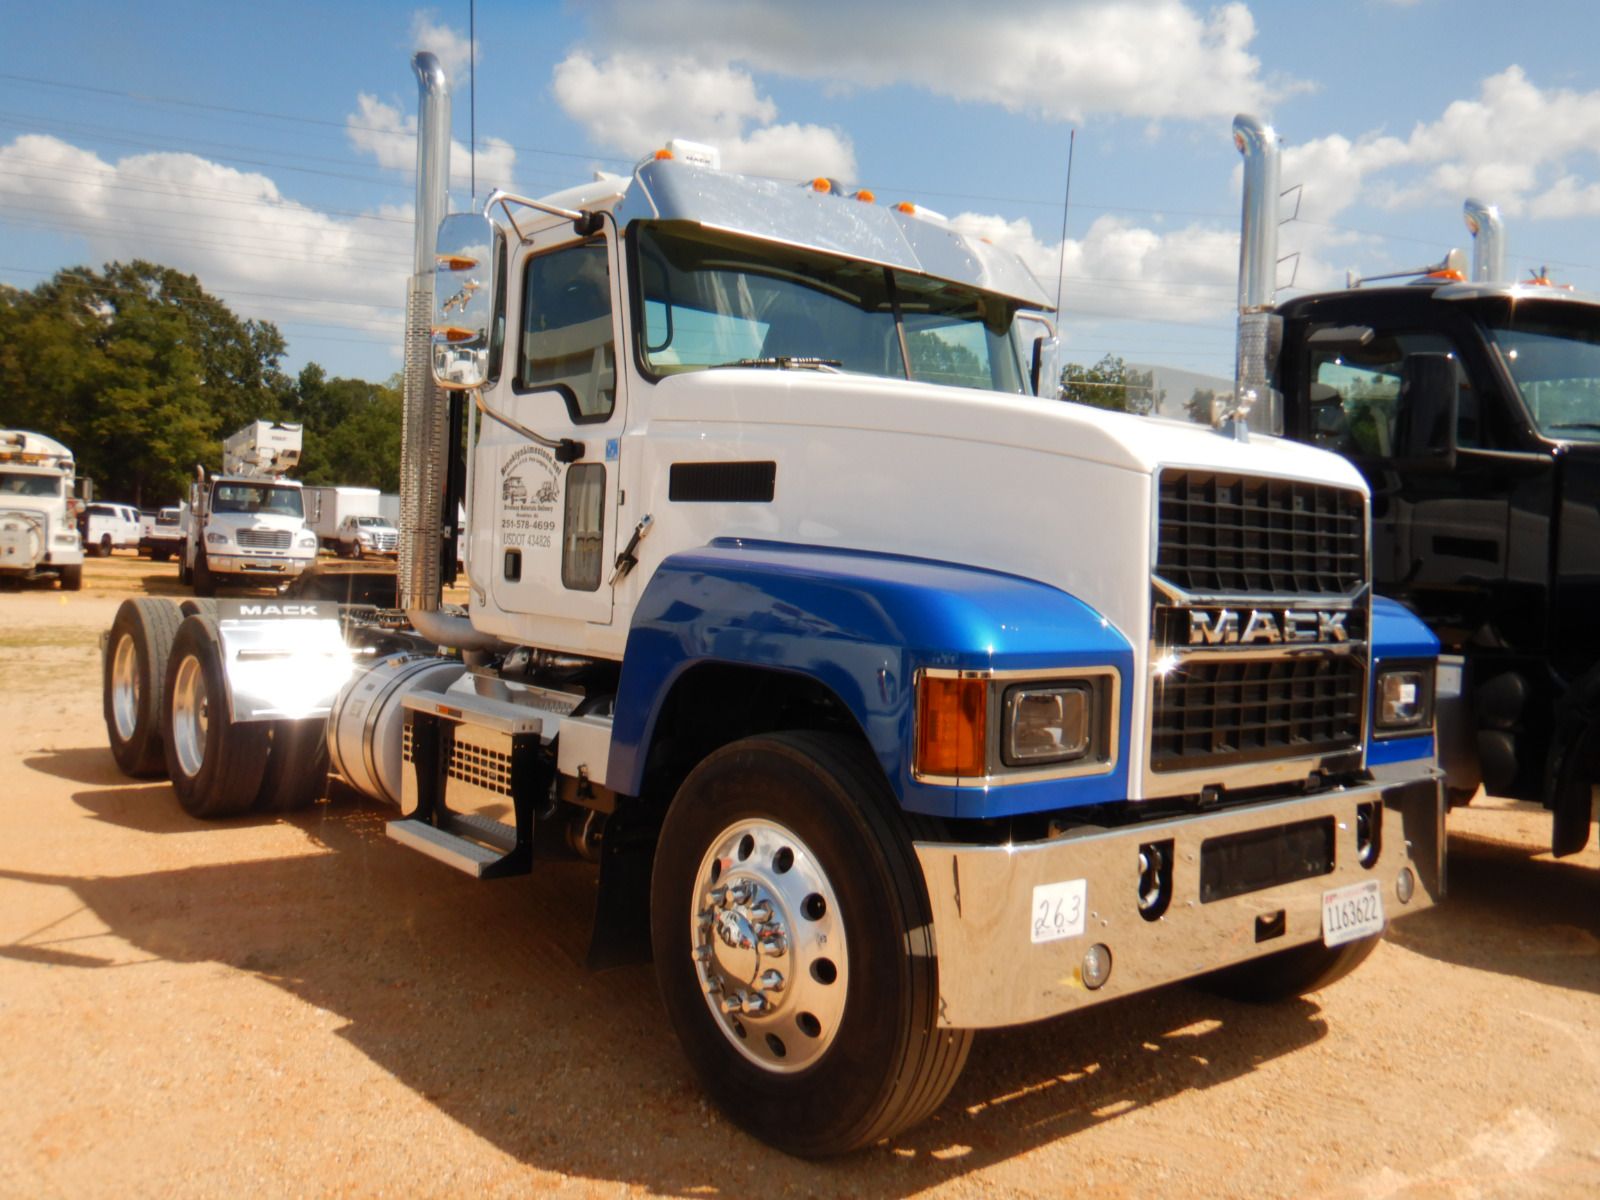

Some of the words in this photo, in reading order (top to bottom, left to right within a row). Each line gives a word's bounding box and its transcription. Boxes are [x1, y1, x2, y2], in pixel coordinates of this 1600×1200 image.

[502, 519, 555, 531] 251-578-4699
[504, 533, 525, 546] USDOT
[240, 604, 318, 616] MACK
[1189, 608, 1349, 644] MACK
[1034, 895, 1081, 929] 263
[1328, 894, 1378, 932] 1163622
